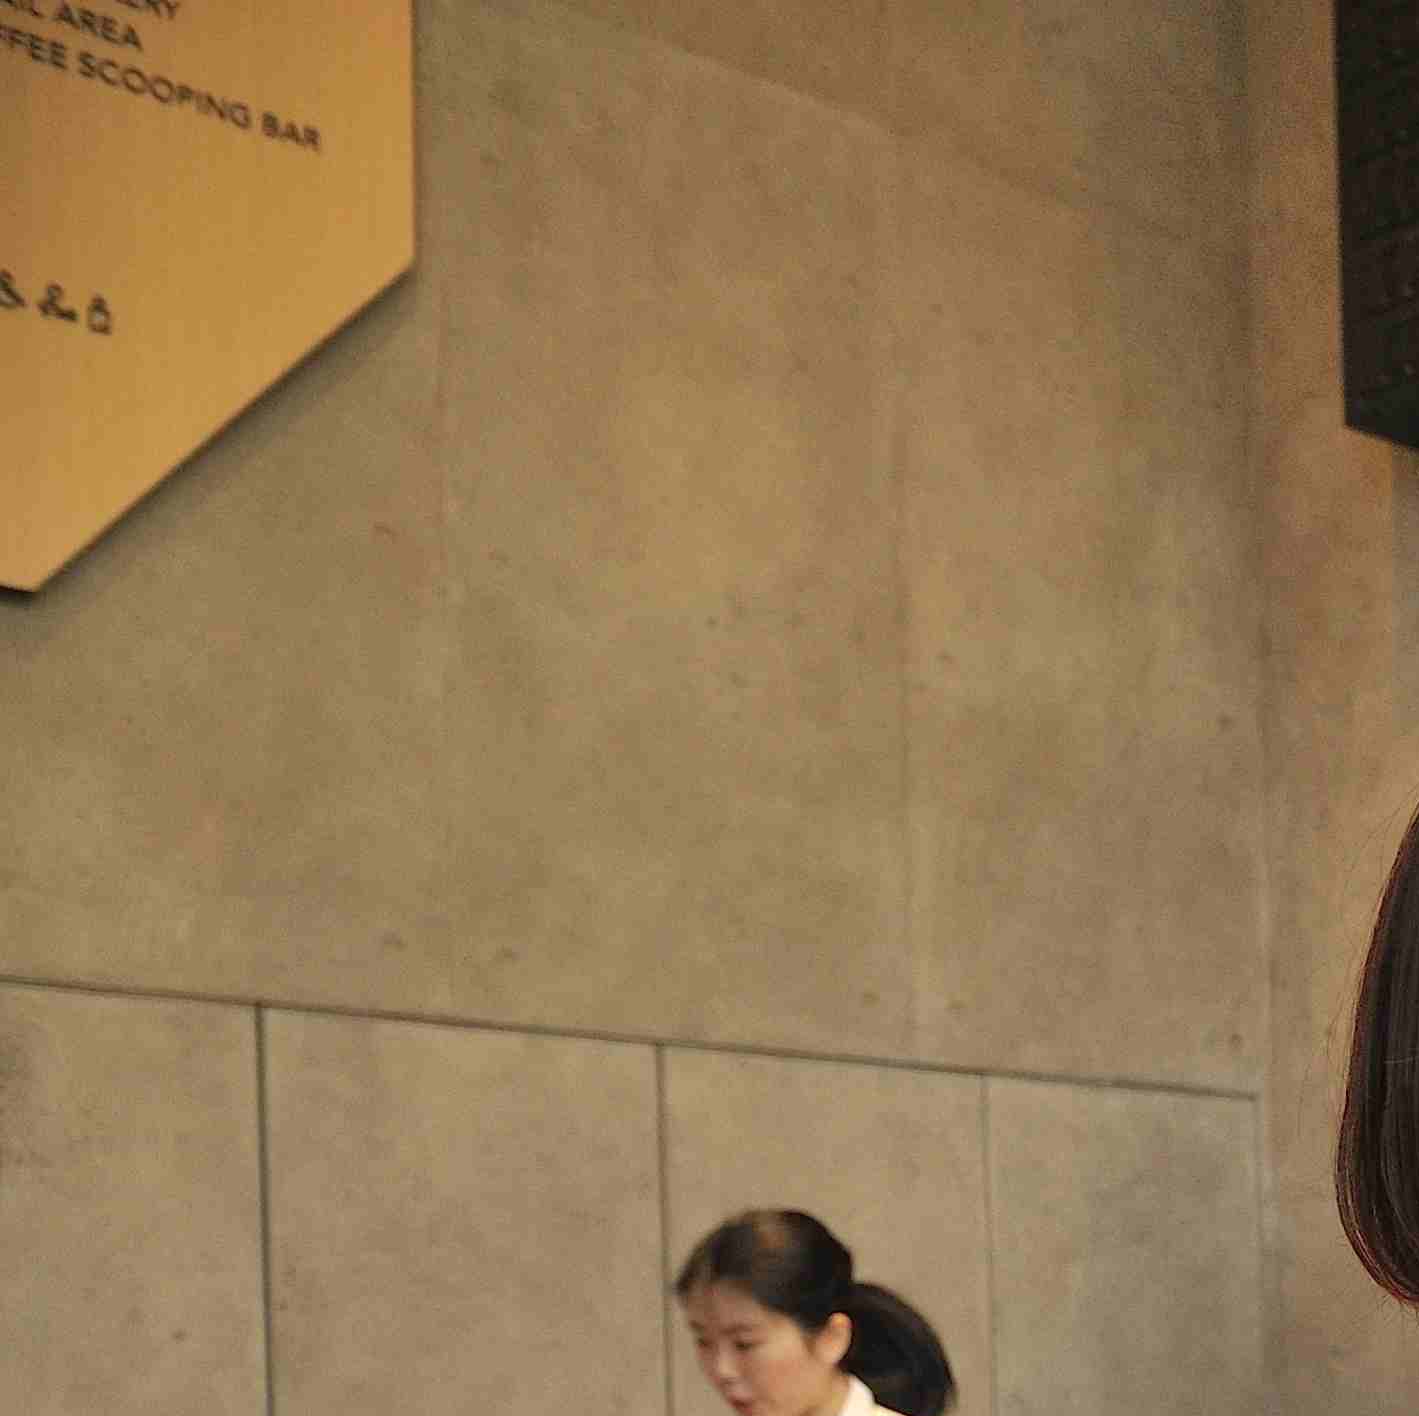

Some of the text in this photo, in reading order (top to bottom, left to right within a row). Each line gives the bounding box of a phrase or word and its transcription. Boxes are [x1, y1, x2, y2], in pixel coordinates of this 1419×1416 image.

[53, 3, 143, 51] AREA
[78, 51, 252, 130] SCOOPING
[261, 112, 321, 151] BAR
